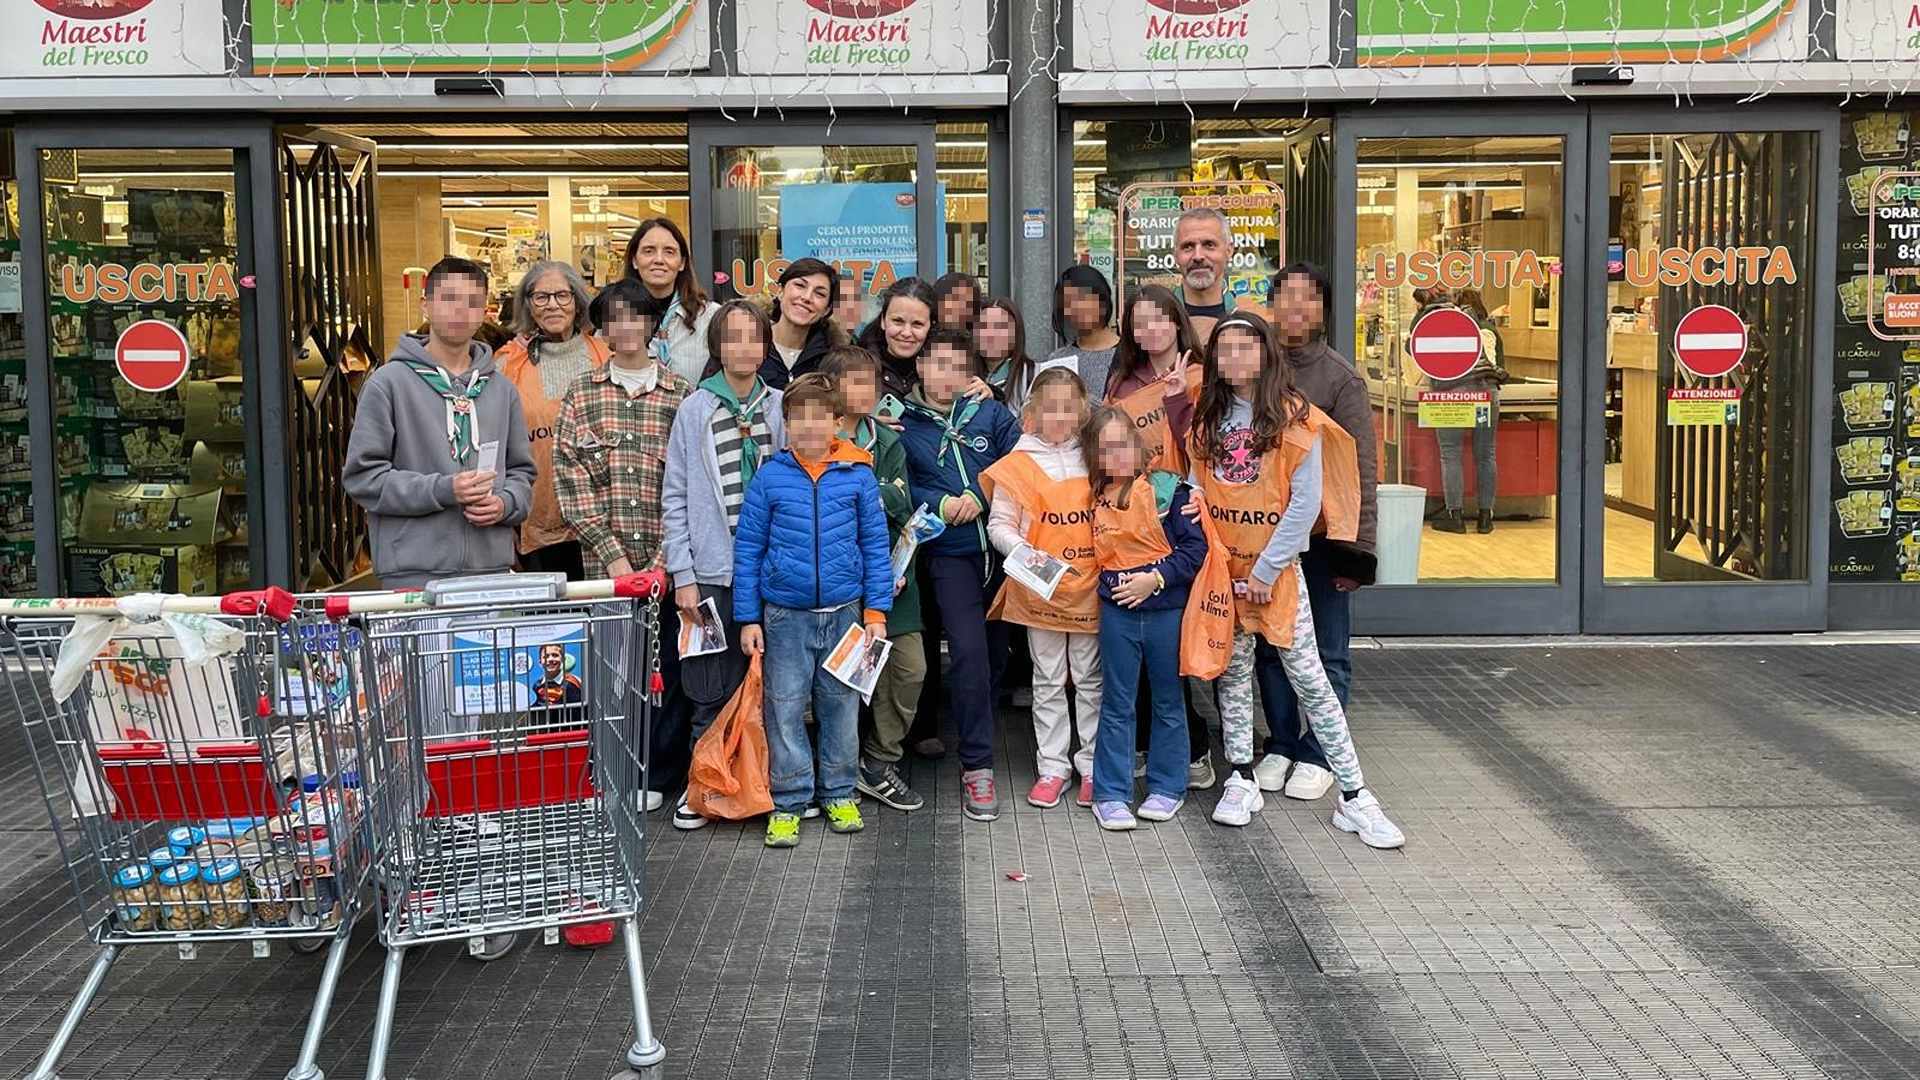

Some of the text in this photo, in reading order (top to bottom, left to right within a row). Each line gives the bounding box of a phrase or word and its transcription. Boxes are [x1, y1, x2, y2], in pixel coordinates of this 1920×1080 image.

[41, 18, 147, 45] Maestri
[807, 17, 911, 43] Maestri
[1145, 13, 1249, 39] Maestri
[42, 45, 149, 66] del Fresco
[808, 43, 911, 64] del Fresco
[1146, 40, 1249, 60] del Fresco
[1880, 206, 1920, 219] ORAR
[817, 226, 850, 236] CERCA
[857, 225, 909, 235] PRODOTTI
[807, 237, 829, 246] CON
[830, 237, 871, 247] QUESTO
[732, 258, 898, 297] USTA
[1373, 249, 1544, 289] USCITA
[1625, 246, 1797, 288] USCITA
[62, 262, 240, 303] USCITA
[1422, 392, 1488, 401] ATTENZIONE!
[1672, 389, 1737, 398] ATTENZIONE!
[1211, 505, 1280, 526] ONTARO
